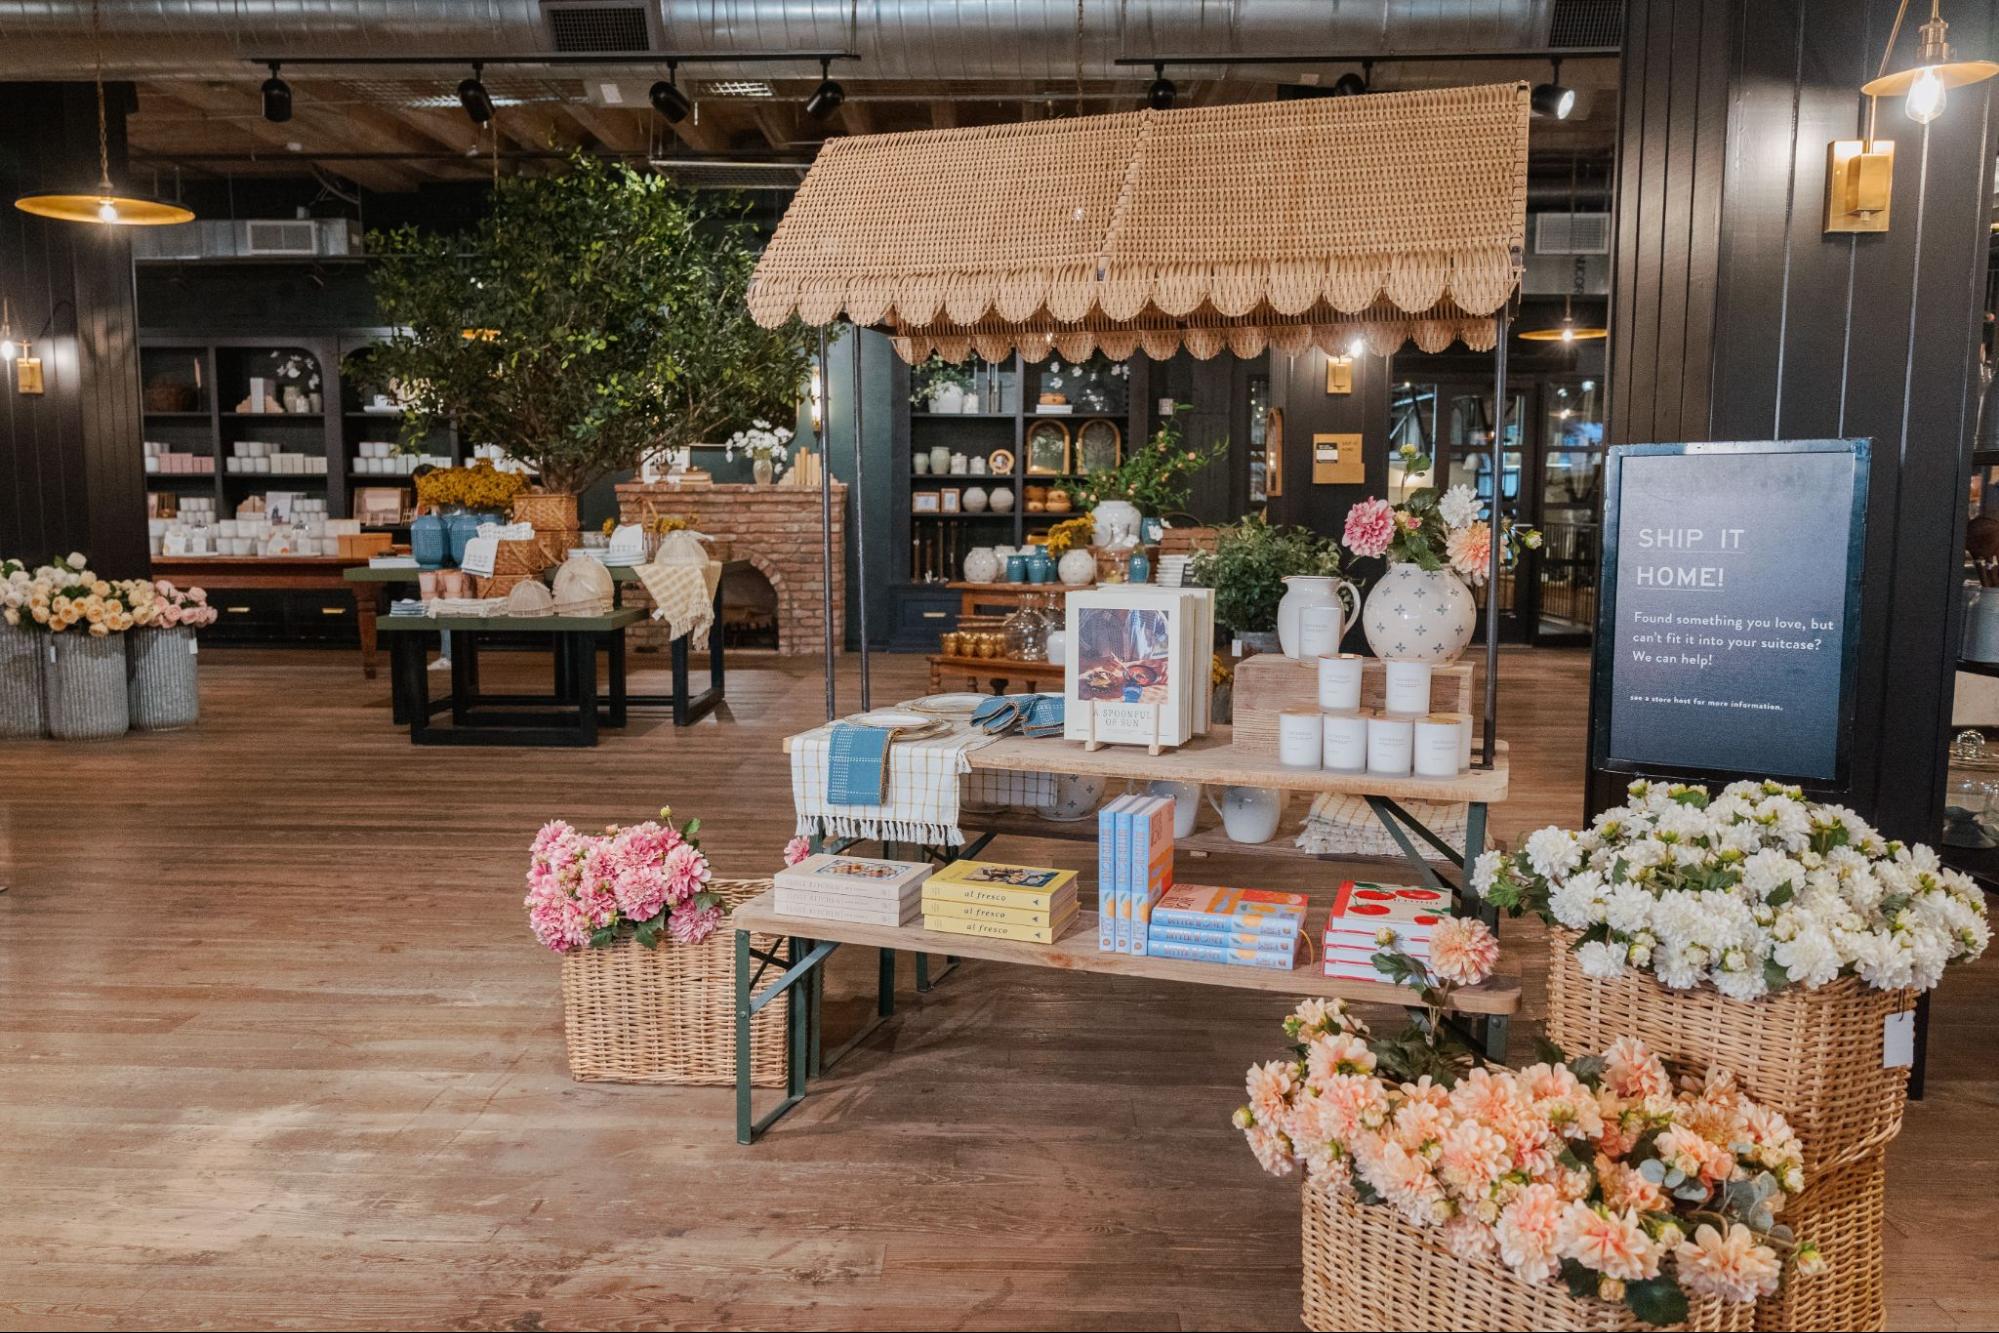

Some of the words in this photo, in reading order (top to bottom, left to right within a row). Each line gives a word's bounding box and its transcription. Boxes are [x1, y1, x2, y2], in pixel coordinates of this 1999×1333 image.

[1638, 528, 1704, 548] SHIP
[1720, 528, 1745, 549] IT
[1636, 566, 1725, 587] HOME!
[1633, 611, 1673, 624] Found
[1676, 613, 1743, 631] something
[1746, 617, 1771, 631] you
[1774, 616, 1807, 632] love,
[1811, 617, 1834, 631] but
[1632, 631, 1663, 644] can't
[1666, 632, 1682, 644] fit
[1685, 634, 1695, 645] it
[1698, 634, 1724, 647] into
[1727, 637, 1757, 650] your
[1760, 637, 1822, 651] suitcase?
[1632, 650, 1653, 663] We
[1655, 654, 1677, 664] can
[1680, 653, 1713, 669] help!
[1707, 700, 1729, 708] more
[1730, 700, 1784, 711] information.
[964, 890, 974, 898] al
[976, 891, 1007, 902] fresco
[963, 907, 973, 915] al
[975, 908, 1006, 919] fresco
[966, 923, 976, 931] al
[978, 924, 1008, 935] fresco
